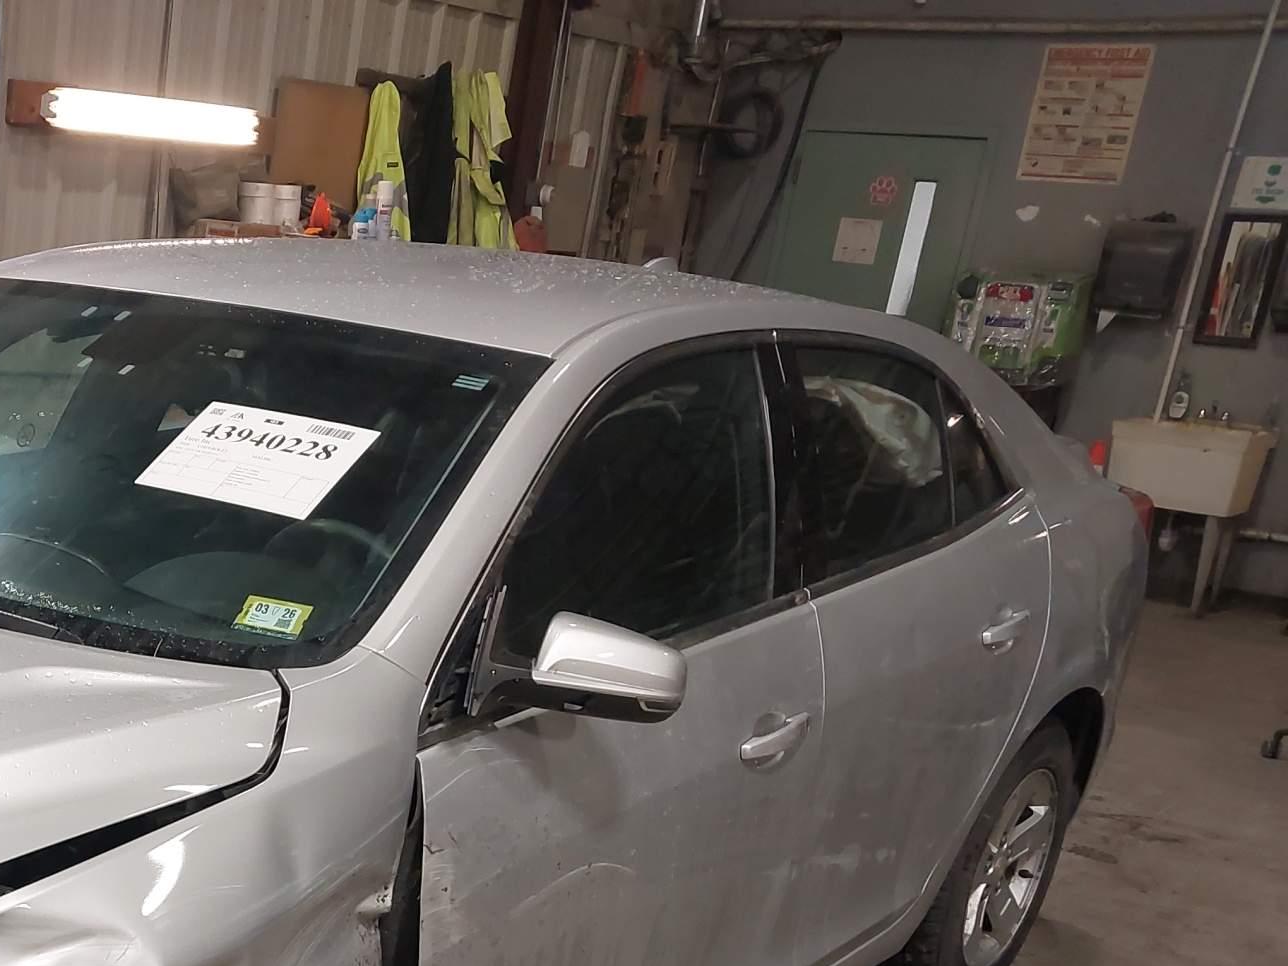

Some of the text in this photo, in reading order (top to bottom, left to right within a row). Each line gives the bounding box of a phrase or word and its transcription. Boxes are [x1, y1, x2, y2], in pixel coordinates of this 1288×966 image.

[201, 423, 338, 461] 43940228
[254, 602, 297, 619] 03 26
